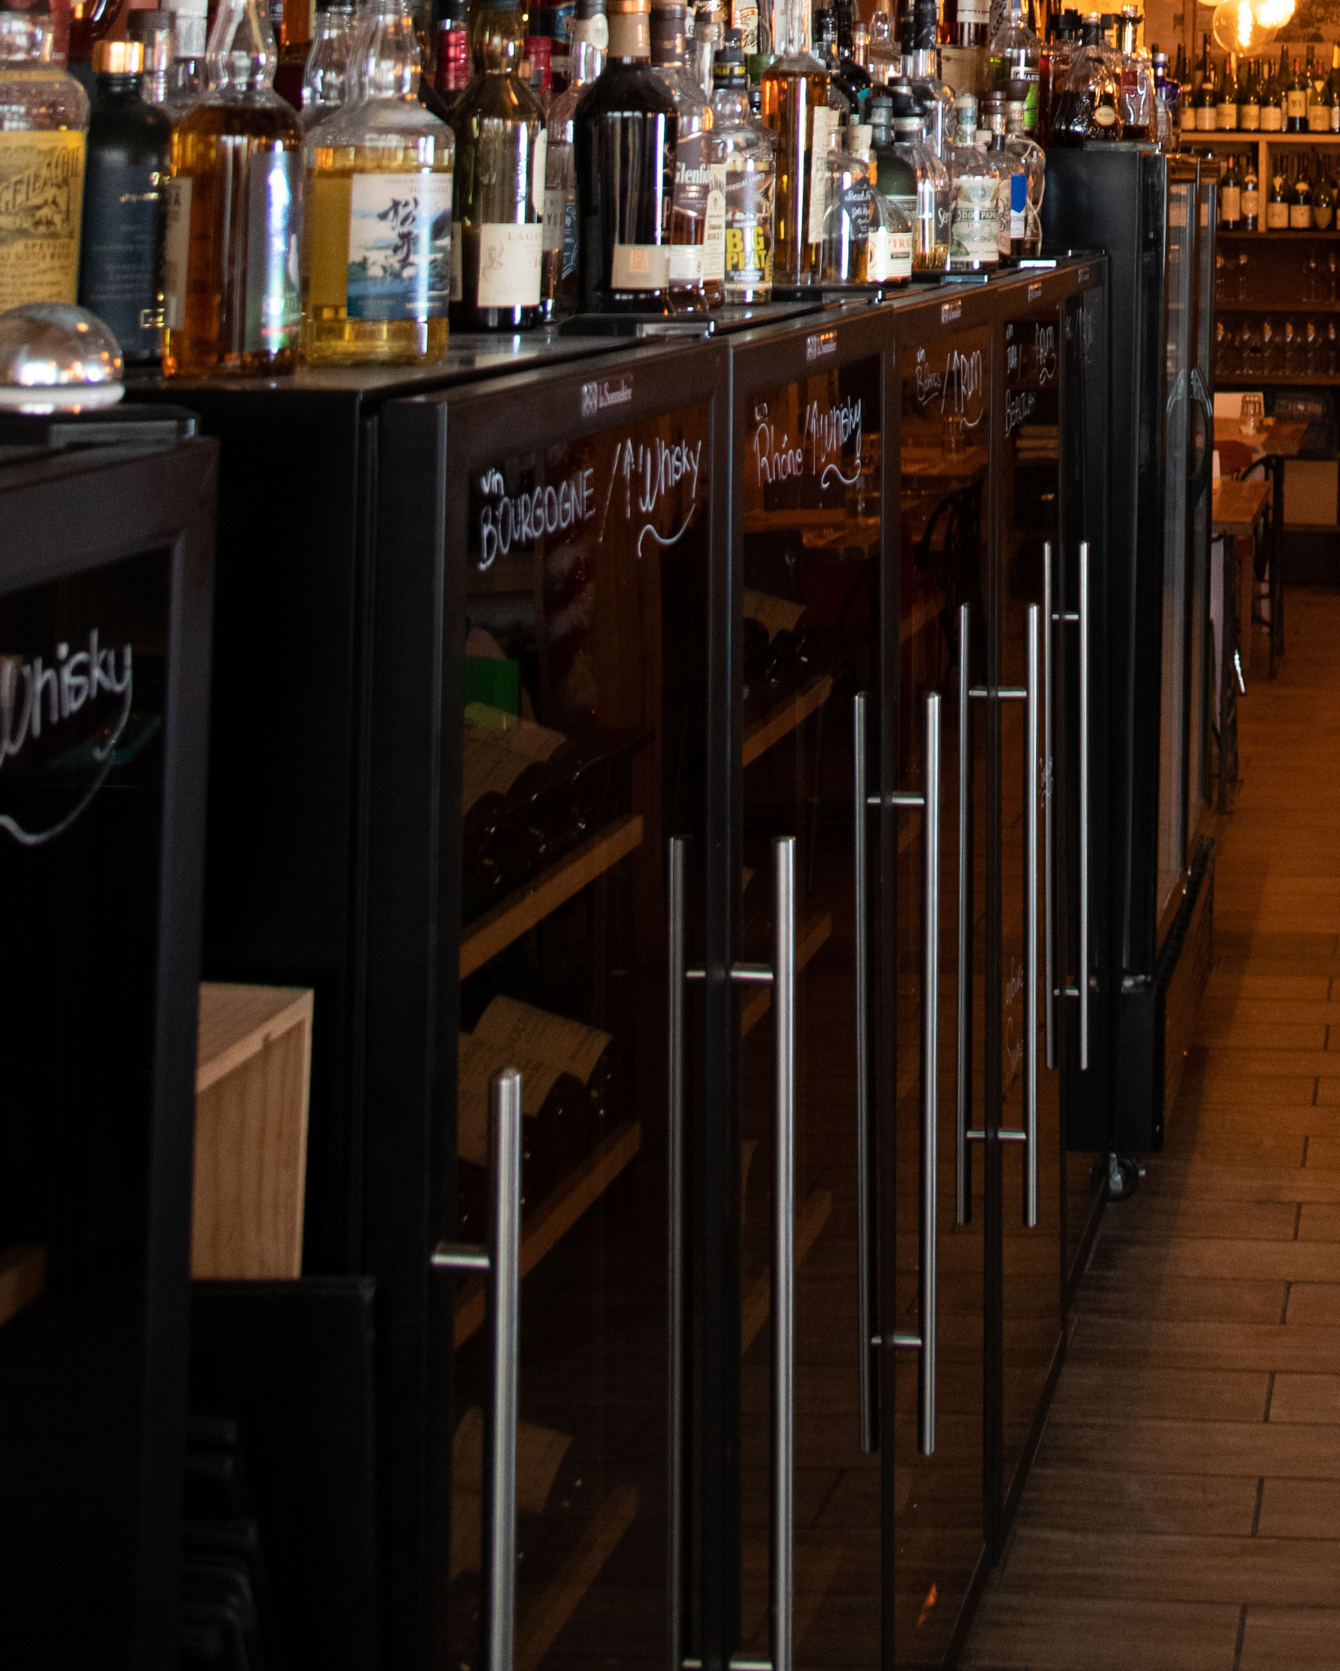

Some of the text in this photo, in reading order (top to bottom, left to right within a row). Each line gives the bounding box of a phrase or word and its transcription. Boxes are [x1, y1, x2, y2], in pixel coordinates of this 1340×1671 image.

[675, 161, 709, 184] Glenfi
[507, 231, 543, 241] LAGAV
[725, 225, 765, 253] BIG
[886, 236, 912, 249] PYRA
[725, 249, 767, 272] PEAT
[752, 422, 804, 488] Rhône
[479, 466, 506, 497] vin
[477, 435, 703, 572] BOURGOGNE Whisky
